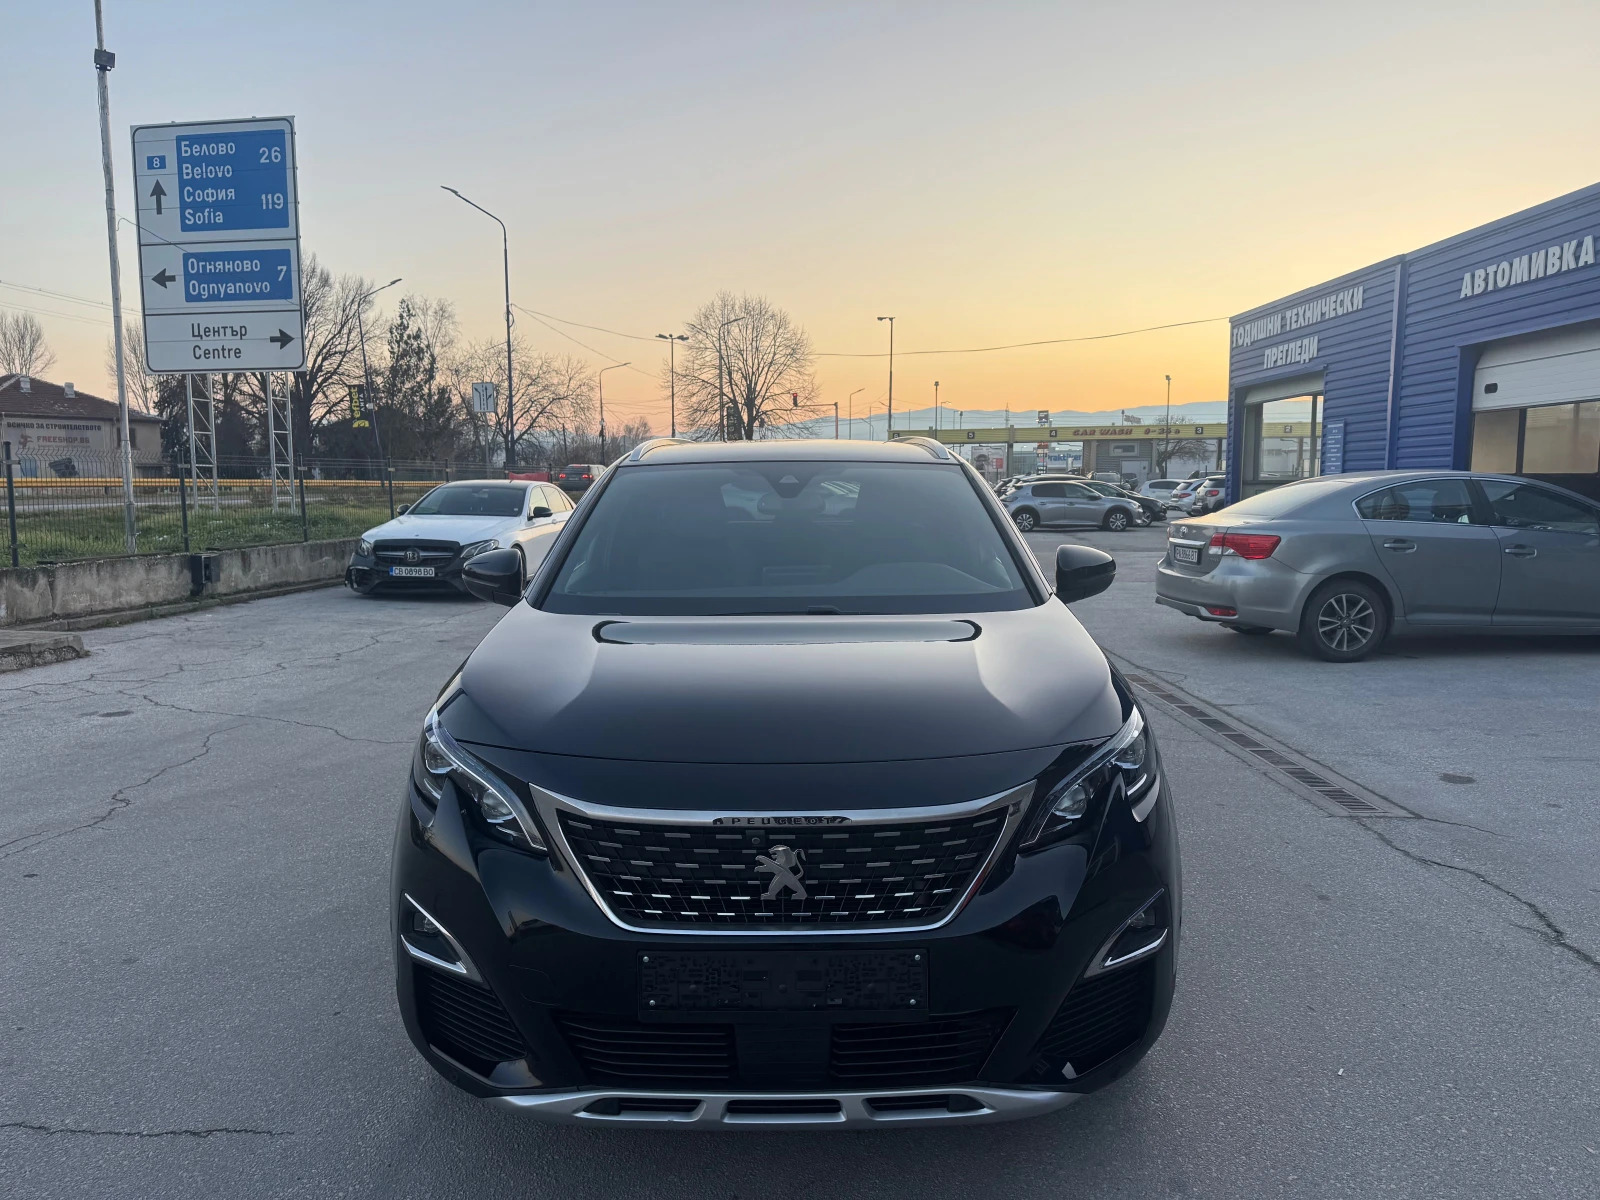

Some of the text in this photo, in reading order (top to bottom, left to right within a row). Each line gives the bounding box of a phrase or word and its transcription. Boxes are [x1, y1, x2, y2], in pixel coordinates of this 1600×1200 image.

[181, 141, 281, 163] Белово 26
[153, 157, 160, 168] 8
[182, 163, 233, 179] Belovo
[184, 186, 284, 209] София 119
[185, 208, 224, 225] Sofia
[188, 258, 288, 282] Огняново 7
[1460, 235, 1595, 298] АВТОМИВКА
[189, 280, 271, 298] Ognyanovo
[1233, 285, 1363, 347] ГОДИШНИ ТЕХНИЧЕСКИ
[191, 323, 248, 340] Център
[192, 344, 242, 360] Centre
[1263, 335, 1319, 369] ПРЕГЛЕДИ
[351, 387, 360, 418] efbet
[1100, 428, 1133, 436] WASH
[731, 816, 832, 826] PEUGEOT
